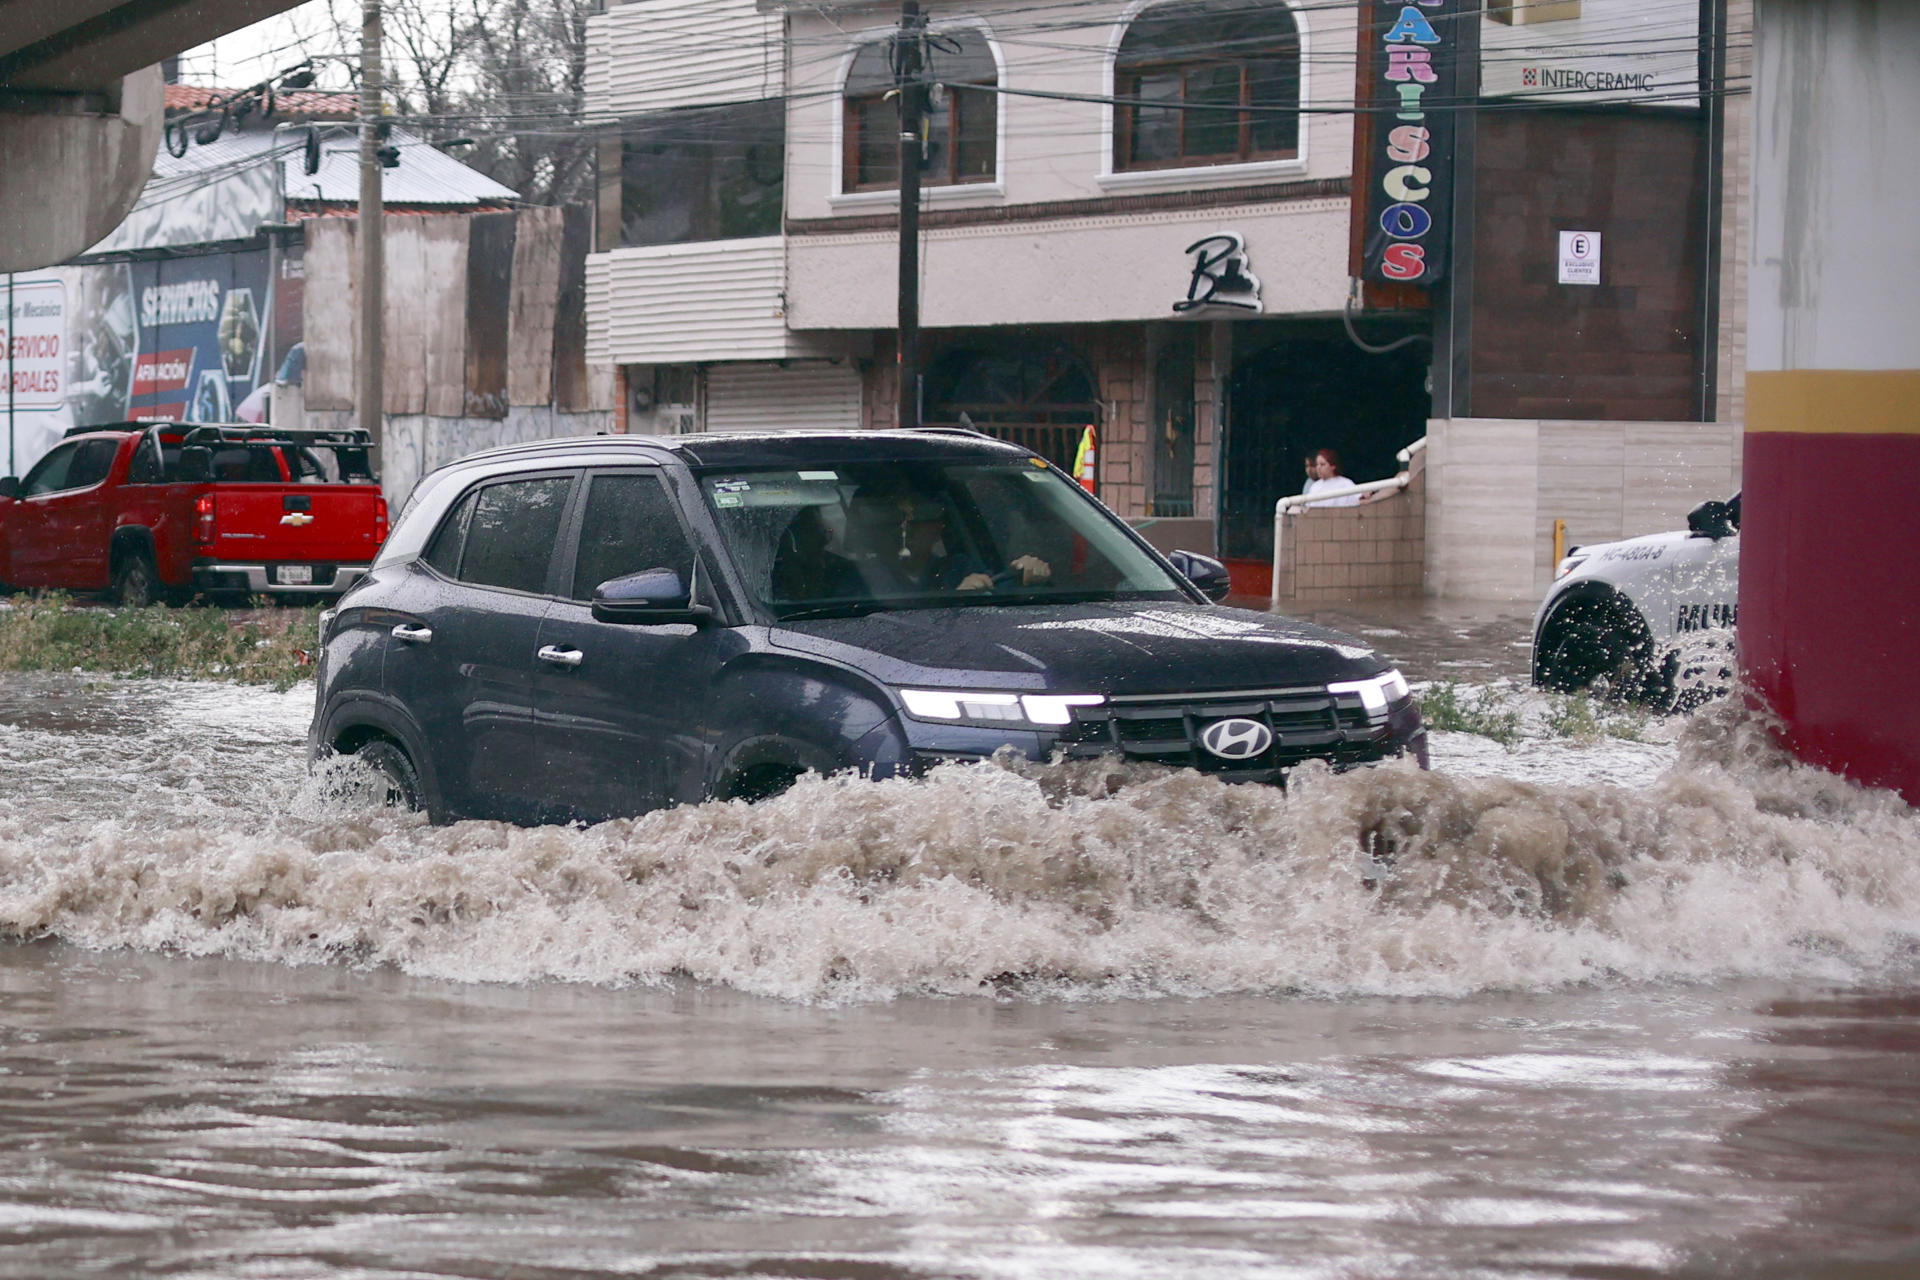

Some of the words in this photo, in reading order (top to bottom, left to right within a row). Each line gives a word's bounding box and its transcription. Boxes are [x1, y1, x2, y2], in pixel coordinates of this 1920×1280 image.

[1541, 68, 1655, 92] INTERCERAMIC
[1380, 0, 1443, 280] ARISCOS
[141, 279, 220, 327] SERVICIOS
